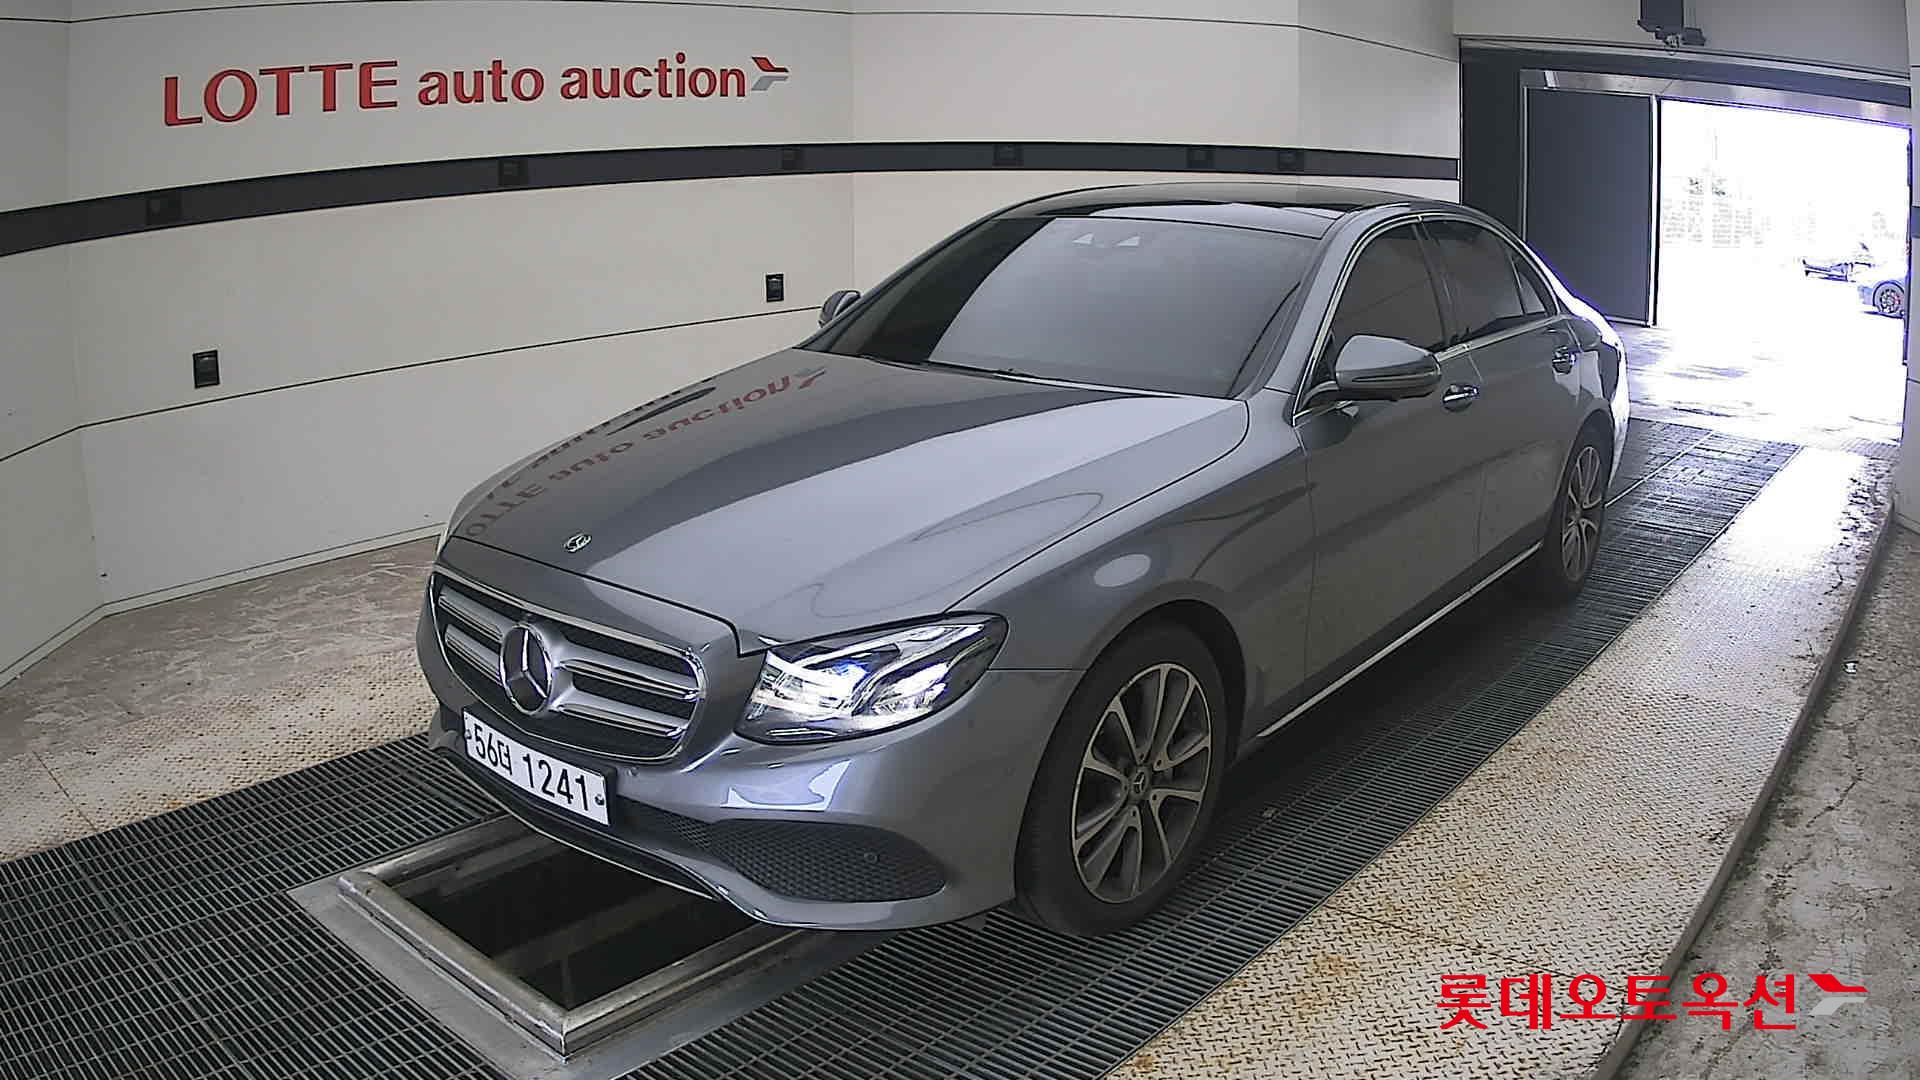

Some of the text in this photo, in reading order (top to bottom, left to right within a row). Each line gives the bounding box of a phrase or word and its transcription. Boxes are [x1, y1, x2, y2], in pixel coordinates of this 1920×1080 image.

[163, 52, 746, 127] LOTTE auto auction
[474, 723, 589, 811] 56더 1241
